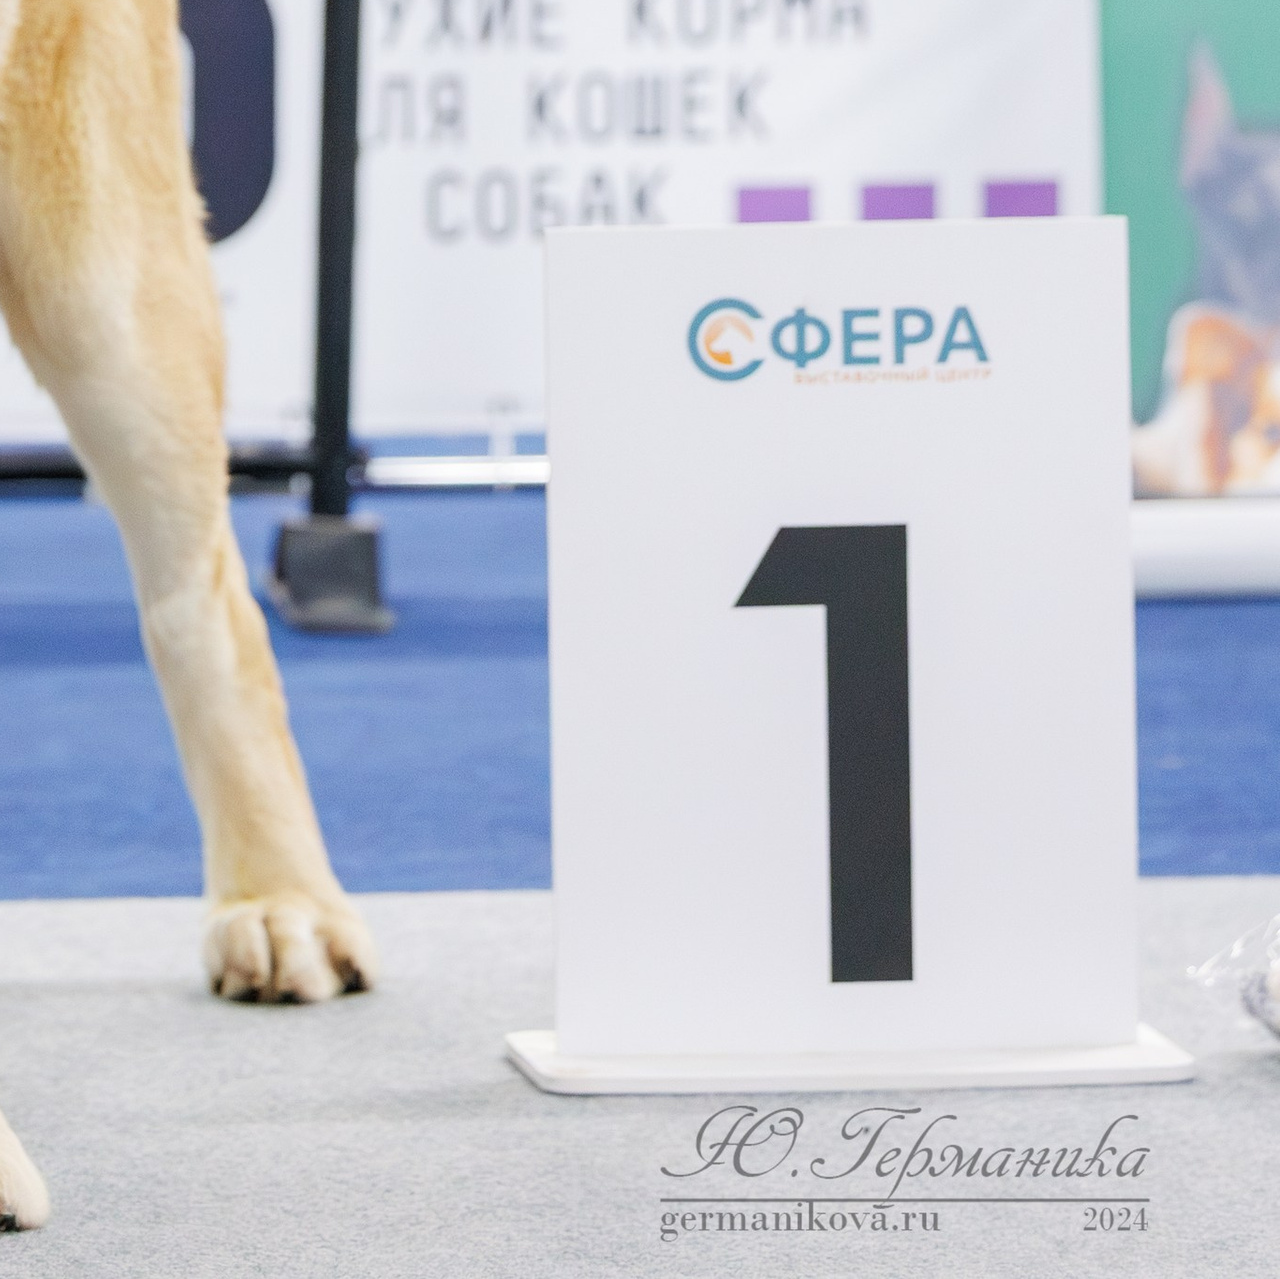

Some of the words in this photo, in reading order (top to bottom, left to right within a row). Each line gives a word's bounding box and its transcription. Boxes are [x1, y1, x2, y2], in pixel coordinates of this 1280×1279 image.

[370, 71, 468, 146] ЛЯ
[527, 67, 769, 144] КОШЕК
[424, 167, 667, 241] СОБАК
[687, 297, 989, 382] СФЕРА
[733, 524, 913, 982] 1
